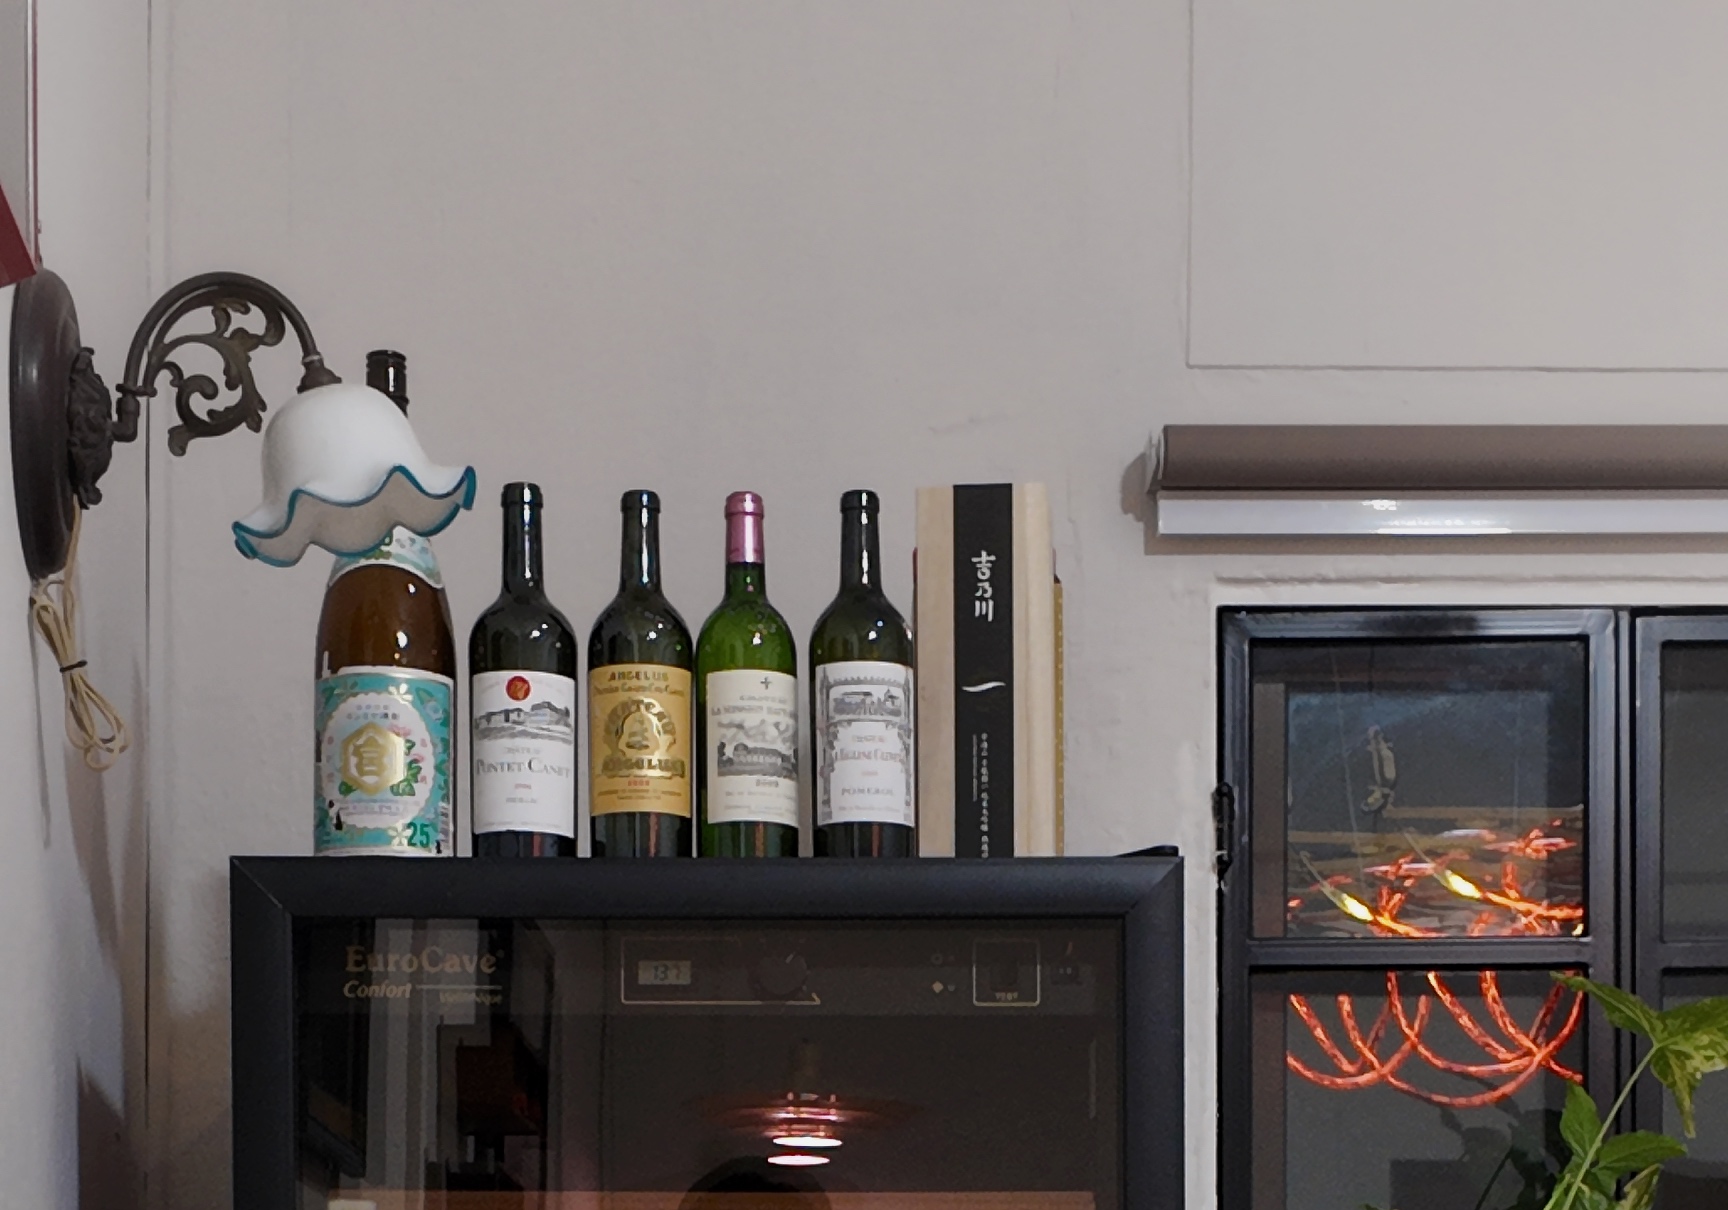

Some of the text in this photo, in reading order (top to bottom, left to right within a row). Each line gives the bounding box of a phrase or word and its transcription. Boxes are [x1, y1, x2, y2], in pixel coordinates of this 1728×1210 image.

[971, 550, 996, 622] 吉乃川
[407, 822, 430, 848] 25
[344, 945, 498, 974] EuroCave
[343, 980, 412, 998] Confort
